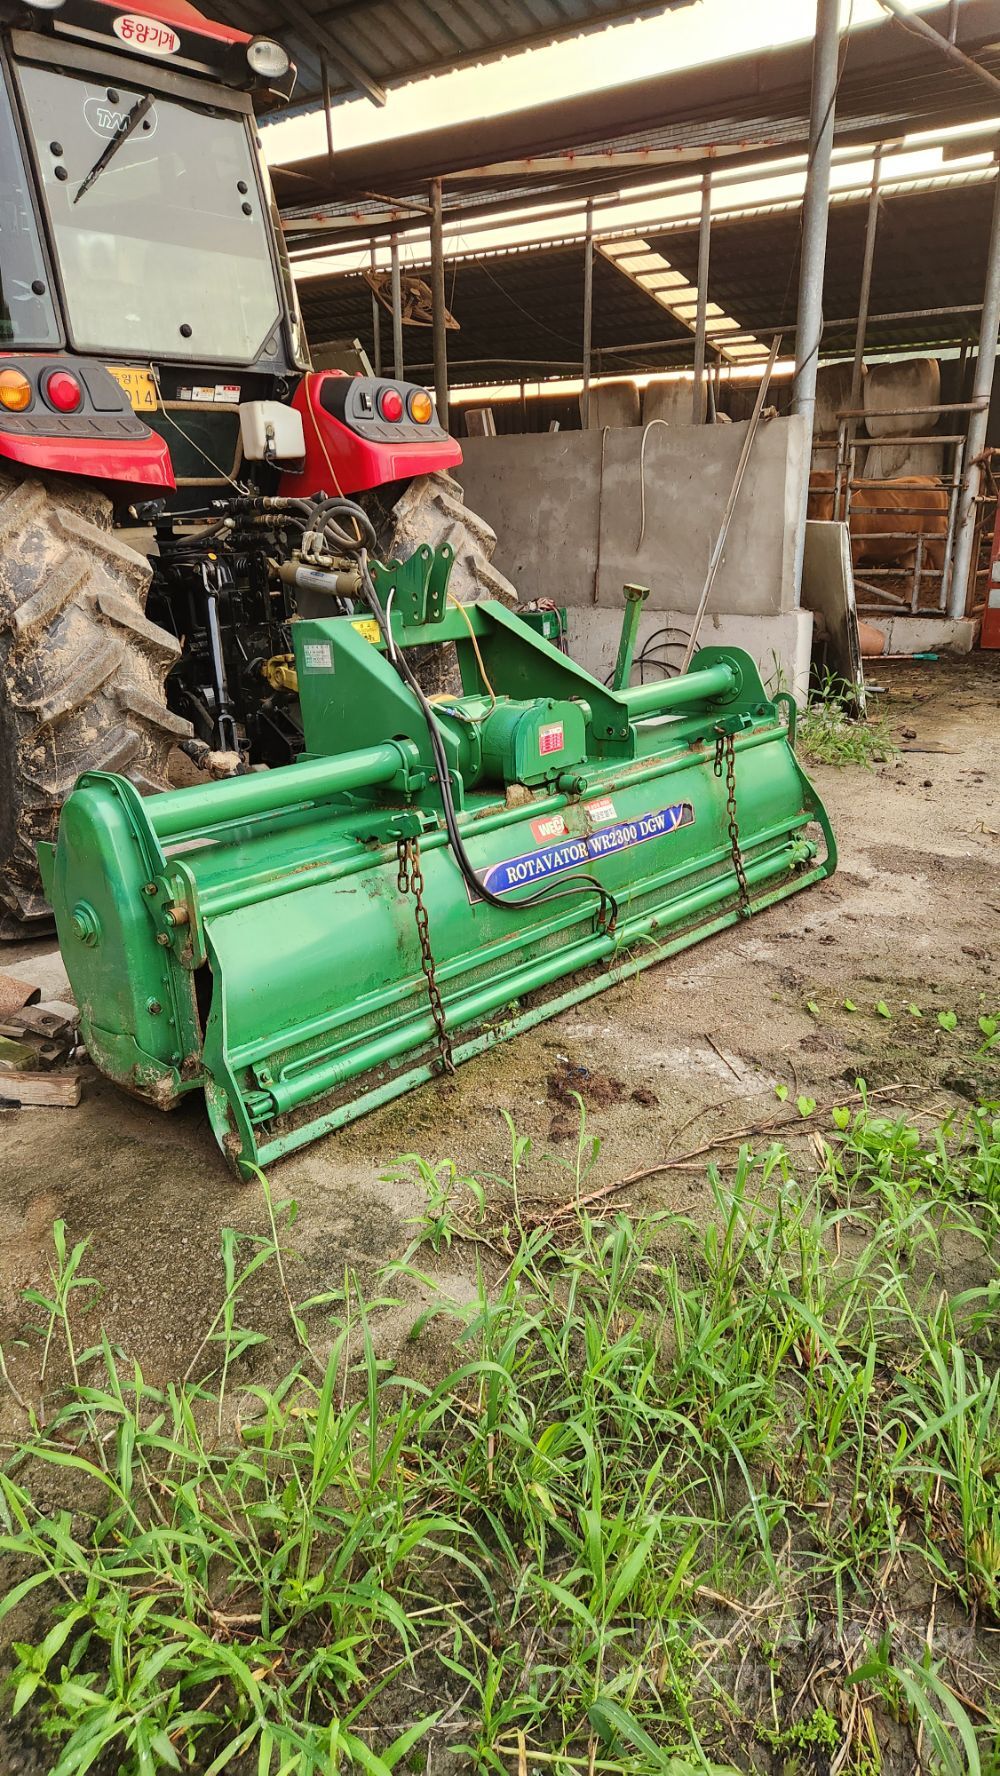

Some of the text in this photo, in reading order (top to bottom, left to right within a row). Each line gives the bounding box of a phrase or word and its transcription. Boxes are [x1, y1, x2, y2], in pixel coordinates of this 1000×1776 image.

[121, 19, 175, 50] 동양기계
[506, 843, 589, 884] ROTAVATOR
[590, 827, 637, 853] WR2300
[640, 815, 666, 836] DGW
